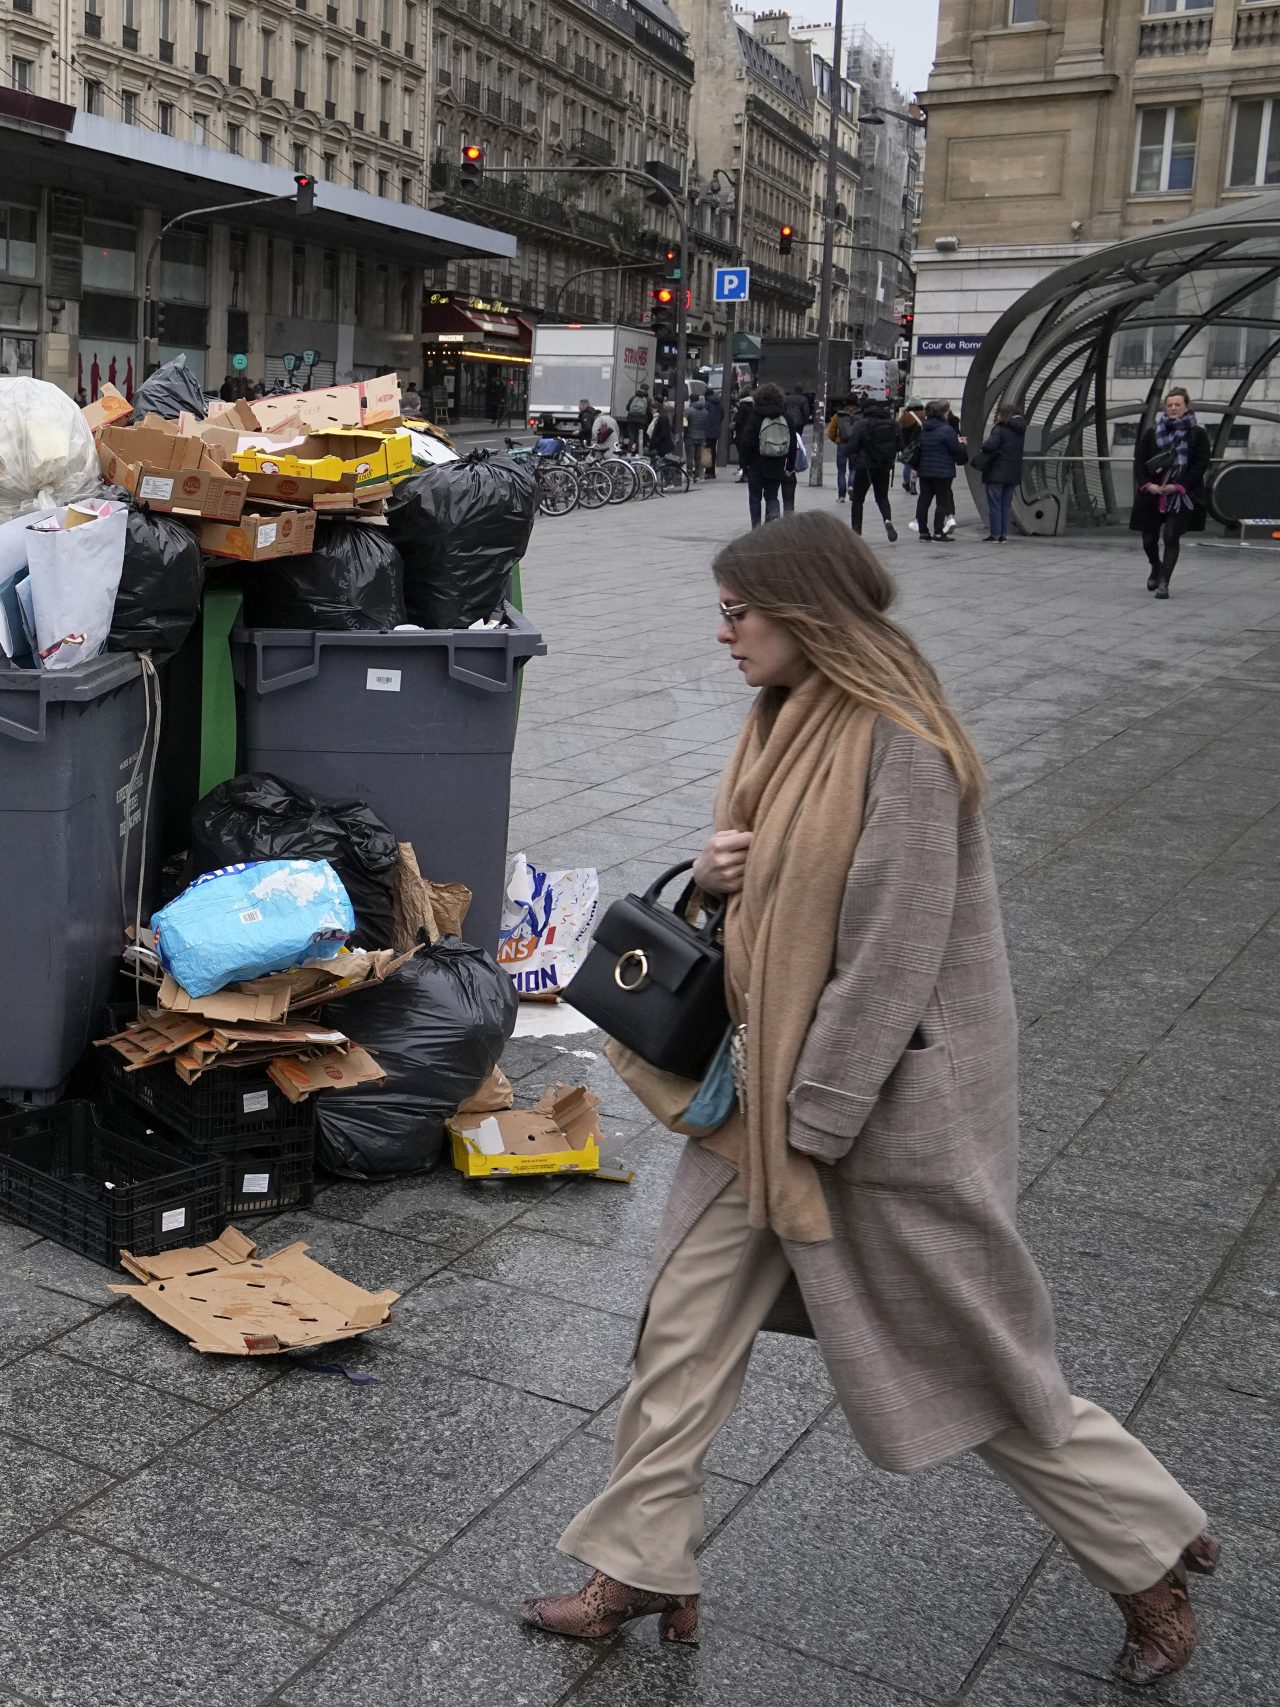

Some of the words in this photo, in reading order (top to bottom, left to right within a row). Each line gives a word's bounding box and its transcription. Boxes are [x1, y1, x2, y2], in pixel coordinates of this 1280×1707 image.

[723, 275, 738, 295] P
[922, 341, 943, 350] Cour
[945, 341, 956, 349] de
